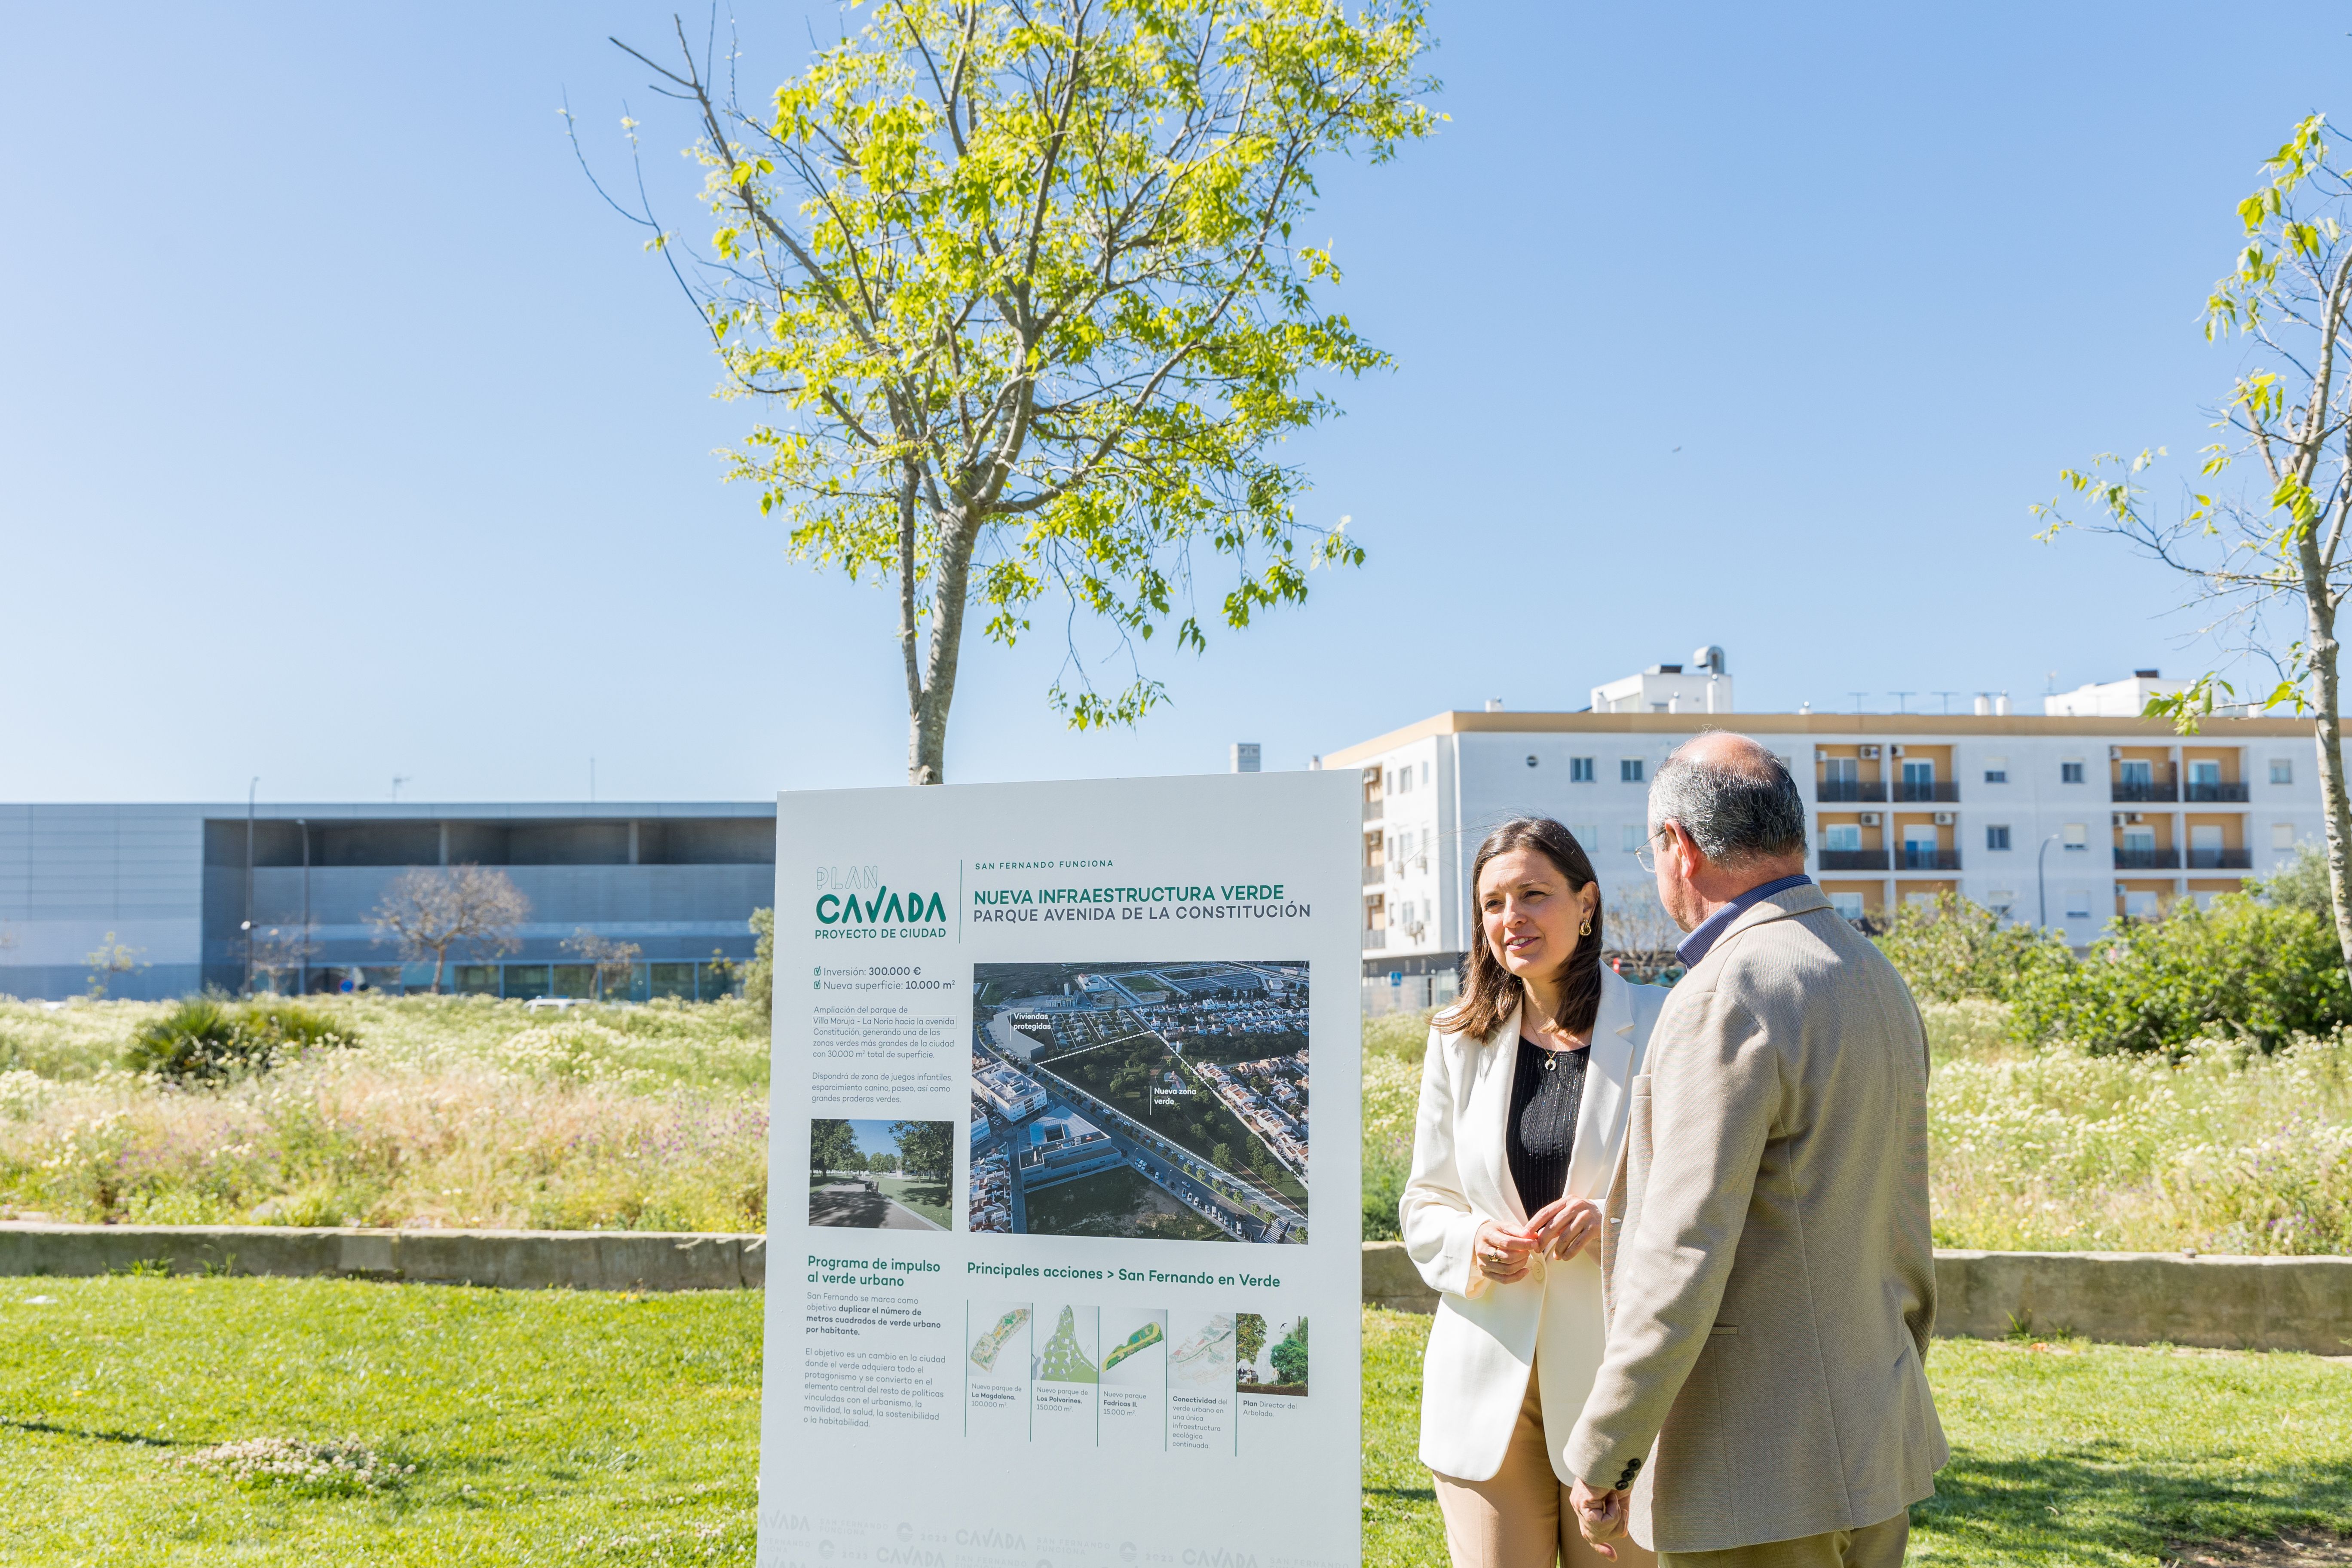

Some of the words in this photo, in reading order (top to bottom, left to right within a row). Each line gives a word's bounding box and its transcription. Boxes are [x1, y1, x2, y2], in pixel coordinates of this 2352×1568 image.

[1000, 861, 1054, 869] FERNANDO
[1060, 860, 1113, 868] FUNCIONA
[817, 865, 878, 890] PLAN
[975, 890, 1033, 905] NUEVA
[1039, 886, 1215, 904] INFRAESTRUCTURA
[1221, 885, 1283, 900] VERDE
[816, 885, 946, 924] CAVADA
[974, 909, 1038, 924] PARQUE
[1044, 907, 1115, 921] AVENIDA
[1122, 907, 1142, 920] DE
[1149, 906, 1170, 919] LA
[1176, 900, 1310, 919] CONSTITUCIÓN
[815, 928, 876, 939] PROYECTO
[882, 929, 896, 938] DE
[900, 928, 946, 938] CIUDAD
[824, 967, 866, 976] Inversión:
[869, 967, 910, 976] 300.000
[913, 967, 921, 975] €
[824, 981, 851, 989] Nueva
[855, 980, 903, 992] superficie:
[906, 981, 940, 989] 10.000
[814, 1006, 854, 1015] Ampliación
[831, 1017, 854, 1026] Maruja
[1014, 1022, 1051, 1031] protegidas
[863, 1028, 901, 1037] generando
[879, 1039, 907, 1049] grandes
[897, 1050, 934, 1060] superficie.
[813, 1072, 848, 1081] Dispondrá
[891, 1073, 915, 1082] juegos
[917, 1073, 952, 1082] infantiles,
[812, 1094, 840, 1103] grandes
[842, 1094, 873, 1104] praderas
[808, 1255, 868, 1270] Programa
[873, 1258, 887, 1269] de
[891, 1258, 940, 1273] impulso
[808, 1271, 818, 1282] al
[822, 1272, 856, 1284] verde
[860, 1273, 904, 1286] urbano
[968, 1262, 1039, 1279] Principales
[1044, 1265, 1102, 1280] acciones
[1119, 1268, 1144, 1281] San
[1149, 1270, 1213, 1284] Fernando
[1219, 1276, 1234, 1285] en
[1239, 1274, 1280, 1287] Verde
[807, 1292, 821, 1300] San
[824, 1292, 858, 1302] Fernando
[807, 1303, 836, 1312] objetivo
[839, 1305, 870, 1314] duplicar
[881, 1307, 910, 1315] número
[836, 1316, 876, 1325] cuadrados
[913, 1320, 940, 1328] urbano
[821, 1326, 860, 1335] habitante.
[815, 1348, 844, 1357] objetivo
[869, 1352, 897, 1360] cambio
[910, 1354, 917, 1362] la
[919, 1354, 945, 1363] ciudad
[805, 1359, 828, 1367] donde
[862, 1363, 895, 1372] adquiera
[897, 1365, 915, 1373] todo
[805, 1372, 856, 1381] protagonismo
[876, 1375, 912, 1384] convierta
[981, 1392, 1015, 1400] Magdalena.
[1173, 1396, 1216, 1404] Conectividad
[1173, 1423, 1220, 1432] infraestructura
[1173, 1432, 1203, 1440] ecológica
